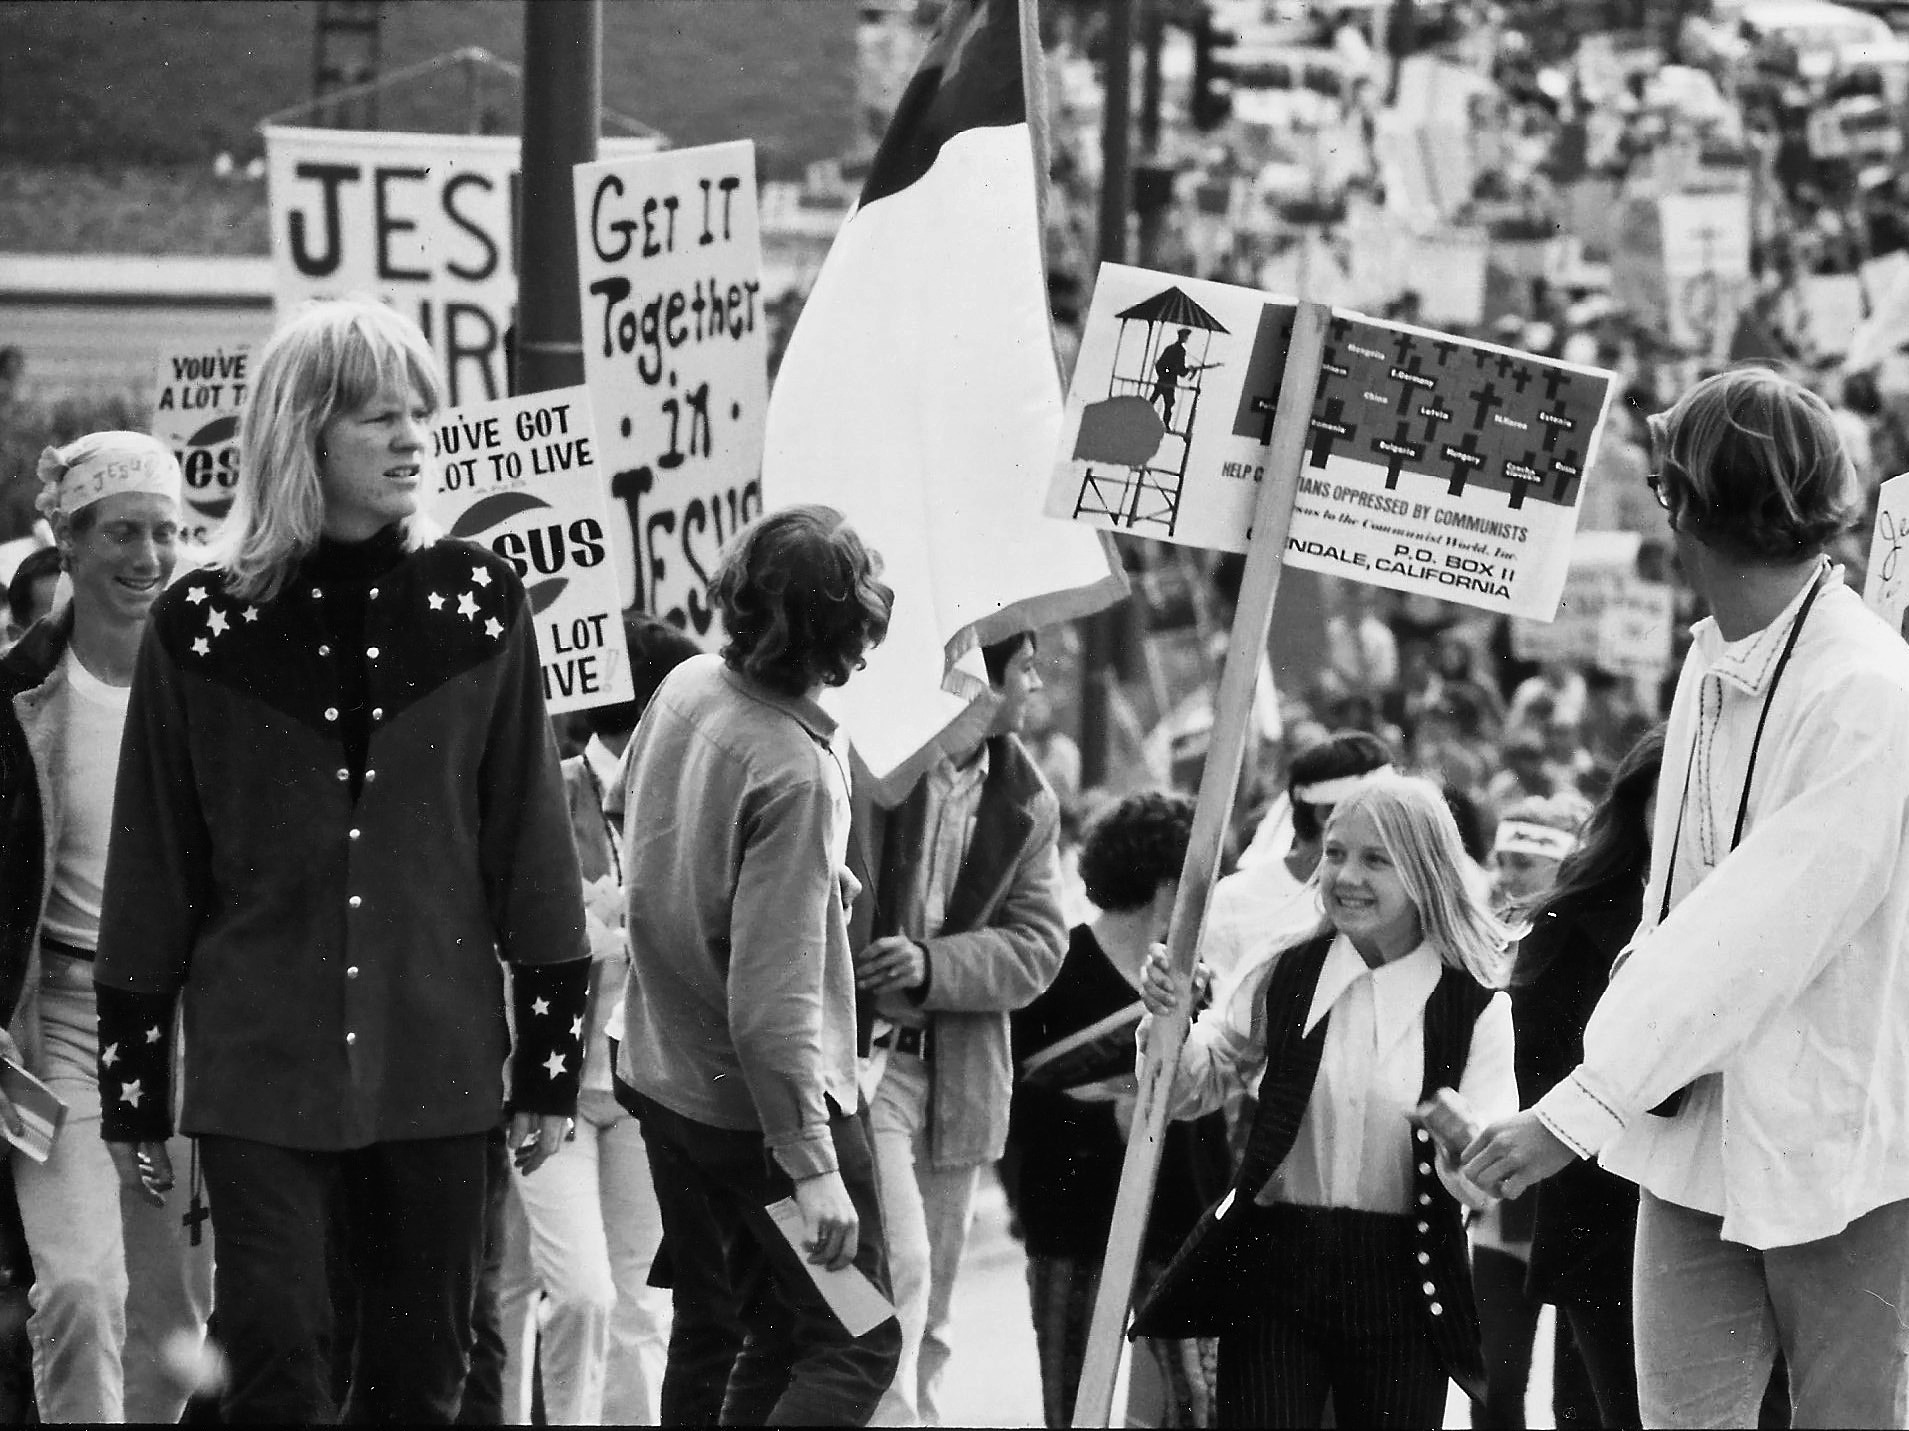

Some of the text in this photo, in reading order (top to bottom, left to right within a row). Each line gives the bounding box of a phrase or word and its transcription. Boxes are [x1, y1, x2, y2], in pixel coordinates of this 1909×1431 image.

[287, 163, 521, 284] JES
[698, 176, 740, 246] IT
[589, 276, 760, 386] Together
[159, 384, 248, 411] A LOT T
[1363, 391, 1388, 404] China
[1421, 406, 1449, 420] Latvia
[516, 405, 570, 442] GOT
[1540, 412, 1571, 428] Estonia
[438, 438, 594, 494] OT TO LIVE
[1379, 440, 1416, 457] Bulgaria
[1446, 446, 1480, 465] Hungary
[1222, 461, 1252, 479] HELP
[1333, 485, 1409, 516] OPPRESSED
[1412, 504, 1432, 520] BY
[1434, 509, 1529, 543] COMMUNISTS
[1323, 509, 1337, 521] to
[1338, 511, 1359, 526] the
[1362, 518, 1443, 545] Communist
[492, 518, 605, 579] SUS
[1394, 544, 1437, 565] P.O.
[1445, 555, 1494, 578] BOX
[1375, 558, 1511, 600] CALIFORNIA
[551, 612, 608, 654] LOT
